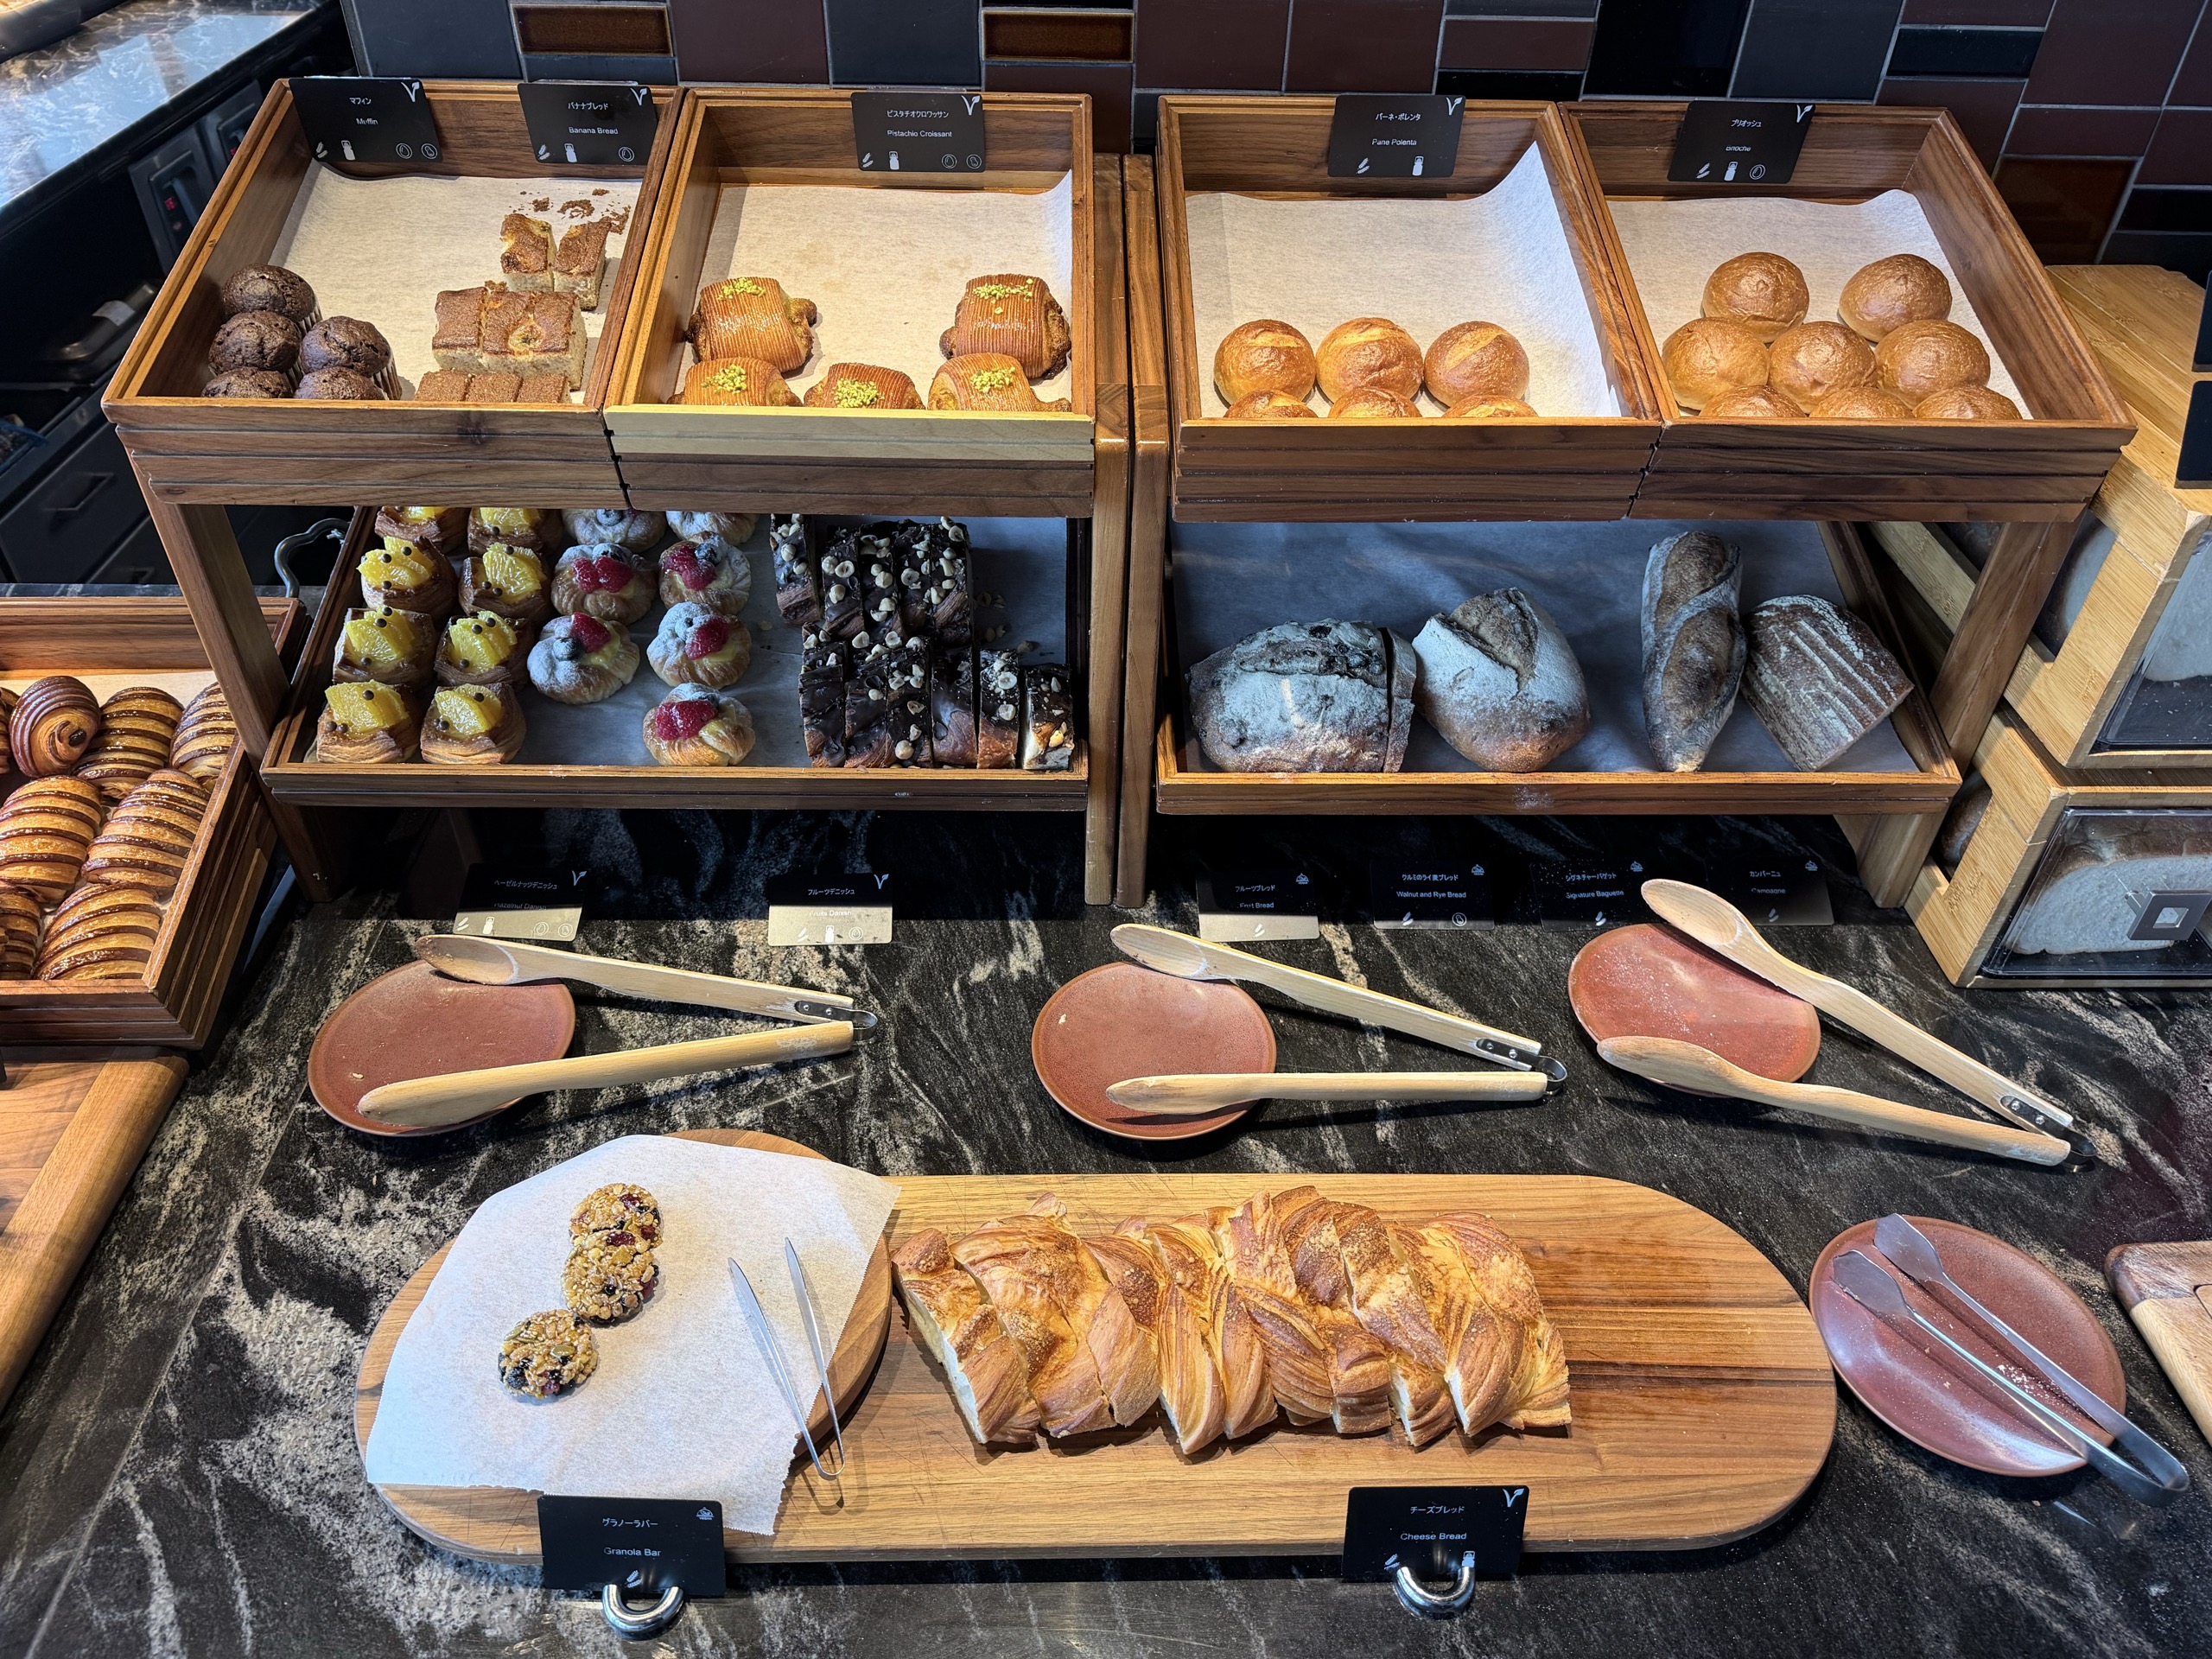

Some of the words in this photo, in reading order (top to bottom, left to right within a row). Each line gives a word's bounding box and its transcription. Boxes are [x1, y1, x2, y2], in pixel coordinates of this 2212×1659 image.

[568, 101, 609, 111] バナナブレッド
[887, 110, 950, 118] ピスタチオクロワッサン
[1731, 118, 1762, 128] ブリオッシュ
[808, 887, 855, 896] フルーツデニッシュ
[1235, 884, 1275, 893] フルーツブレッド
[1566, 891, 1596, 899] Signature
[1409, 1505, 1465, 1515] チーズブレッド
[602, 1518, 658, 1528] グラノーラバー
[1439, 1532, 1467, 1541] Bread
[603, 1547, 642, 1556] Granola
[644, 1548, 662, 1557] Bar
